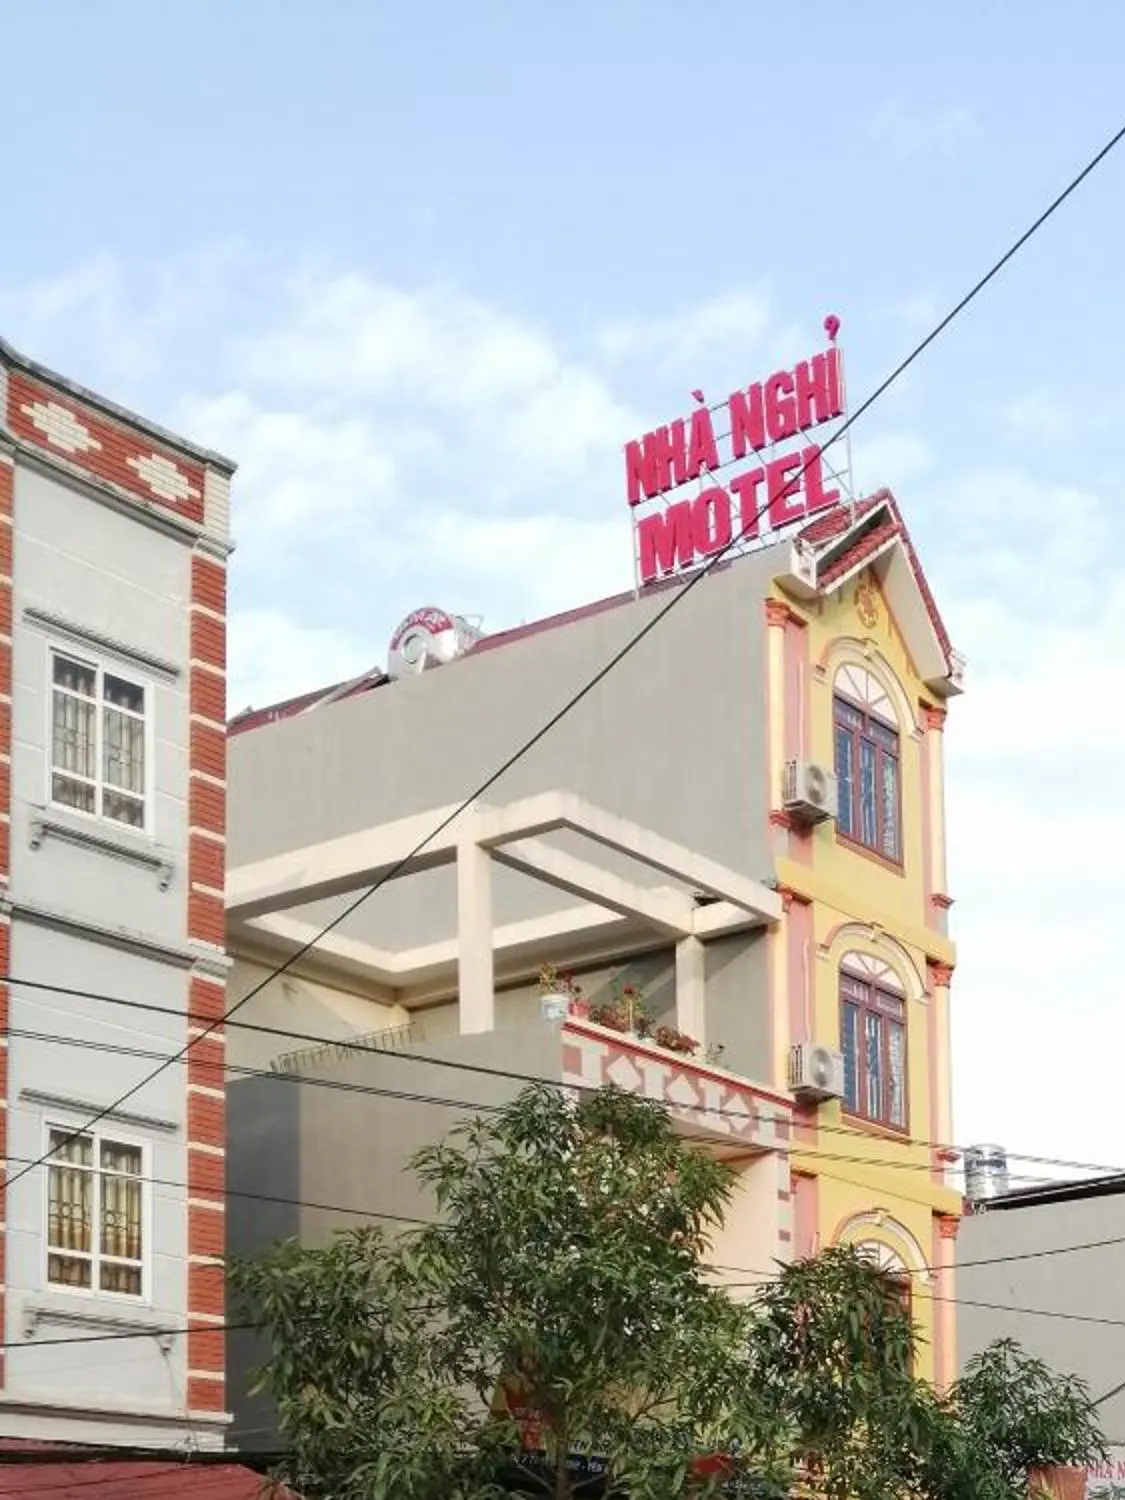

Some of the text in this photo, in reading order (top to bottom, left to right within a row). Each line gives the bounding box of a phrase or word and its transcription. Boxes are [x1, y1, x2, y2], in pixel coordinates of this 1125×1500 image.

[624, 315, 844, 506] NHÀ NGHỈ
[637, 443, 841, 586] MOTEL
